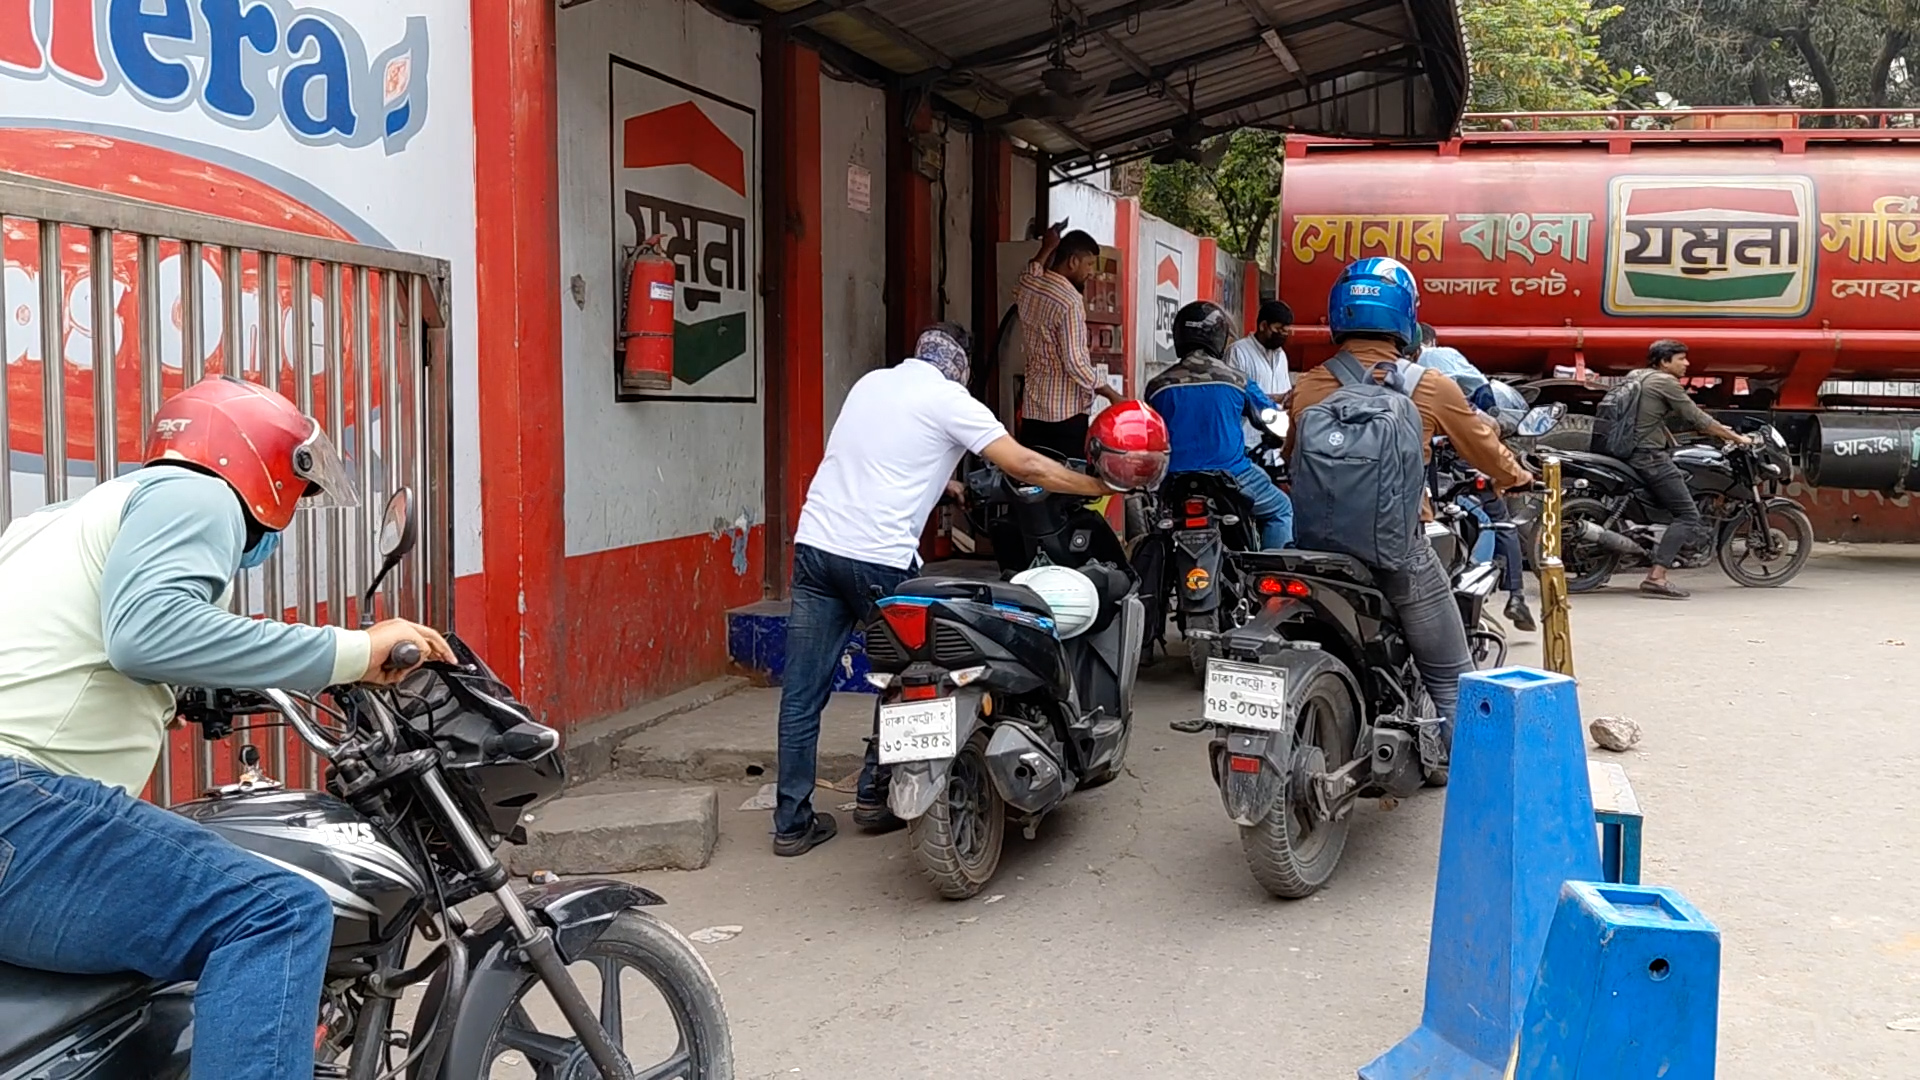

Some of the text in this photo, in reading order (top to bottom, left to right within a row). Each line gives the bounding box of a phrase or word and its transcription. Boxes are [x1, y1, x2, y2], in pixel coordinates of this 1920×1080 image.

[1291, 213, 1594, 264] সোনার বাংলা
[1624, 220, 1799, 275] যমুনা
[1423, 277, 1500, 296] আসাদ
[156, 418, 193, 432] SKT
[317, 822, 376, 845] TVS
